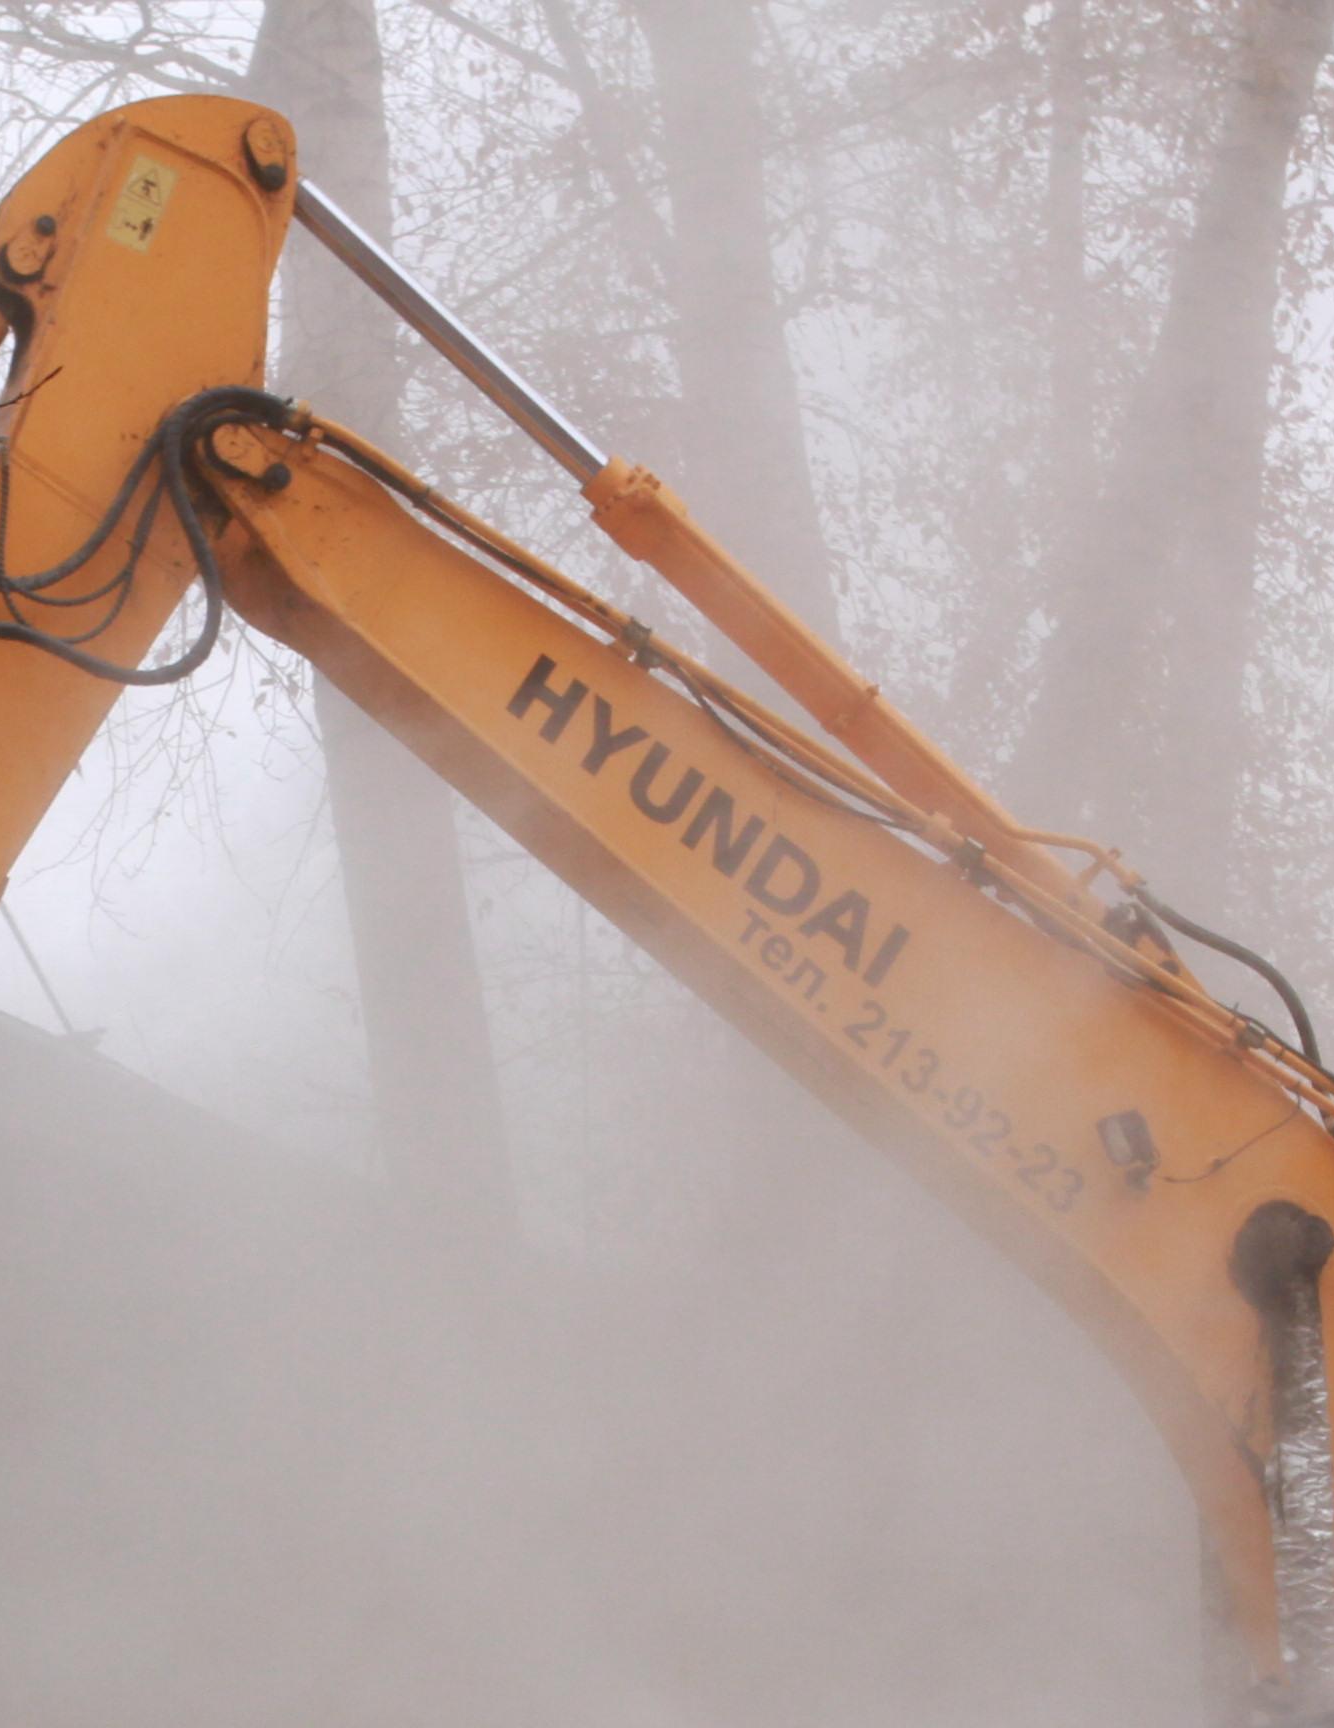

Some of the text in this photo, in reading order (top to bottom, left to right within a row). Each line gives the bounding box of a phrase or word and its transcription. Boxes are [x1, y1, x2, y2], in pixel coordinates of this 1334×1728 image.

[504, 653, 912, 989] HYUNDAI
[737, 907, 1086, 1214] тел. 213-92-23
